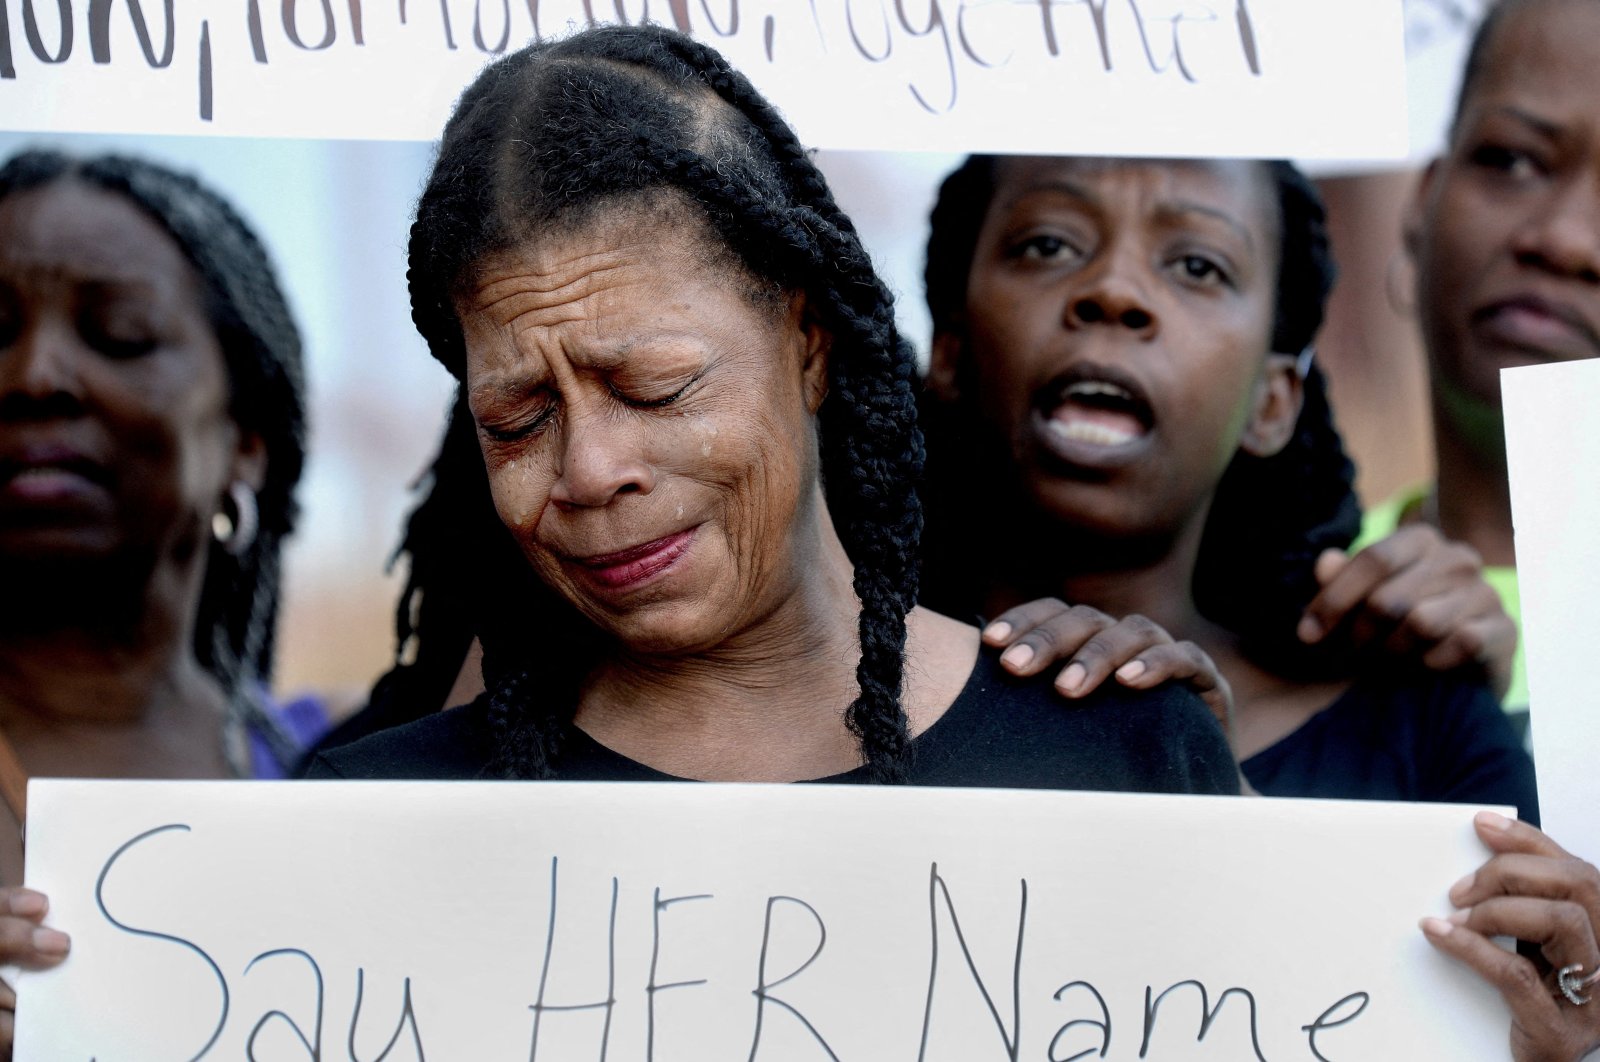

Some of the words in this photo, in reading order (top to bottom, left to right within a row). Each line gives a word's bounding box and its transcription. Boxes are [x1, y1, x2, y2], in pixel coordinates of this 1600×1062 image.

[0, 0, 213, 121] ow,
[808, 0, 1262, 115] ogethe
[527, 855, 841, 1062] HER
[917, 860, 1372, 1062] Name
